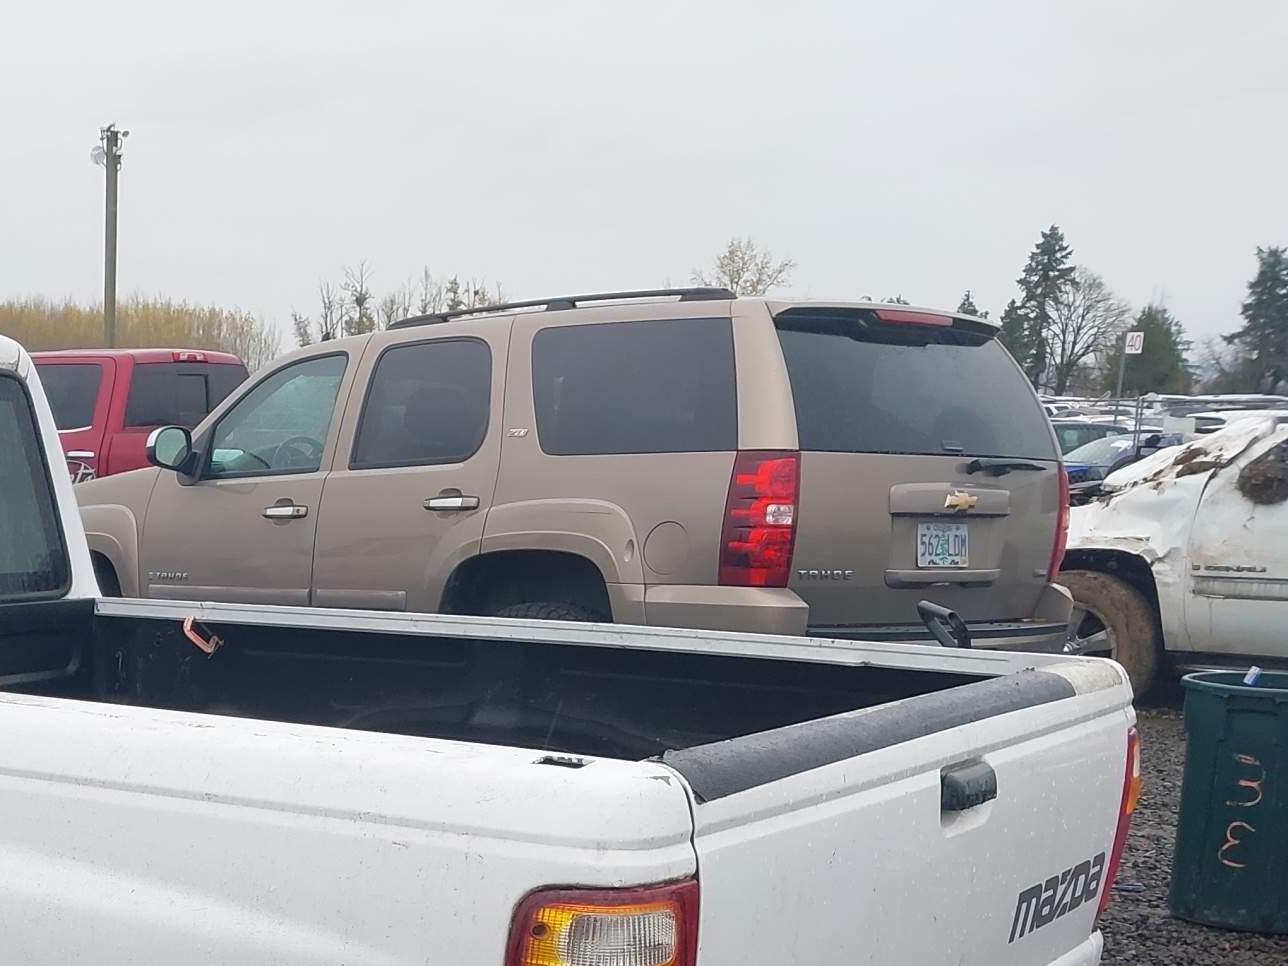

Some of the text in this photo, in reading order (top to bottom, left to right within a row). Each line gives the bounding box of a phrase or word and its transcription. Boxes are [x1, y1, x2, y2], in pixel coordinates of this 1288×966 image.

[1127, 334, 1142, 351] 40
[920, 533, 941, 557] 562
[797, 569, 855, 581] TAHOE
